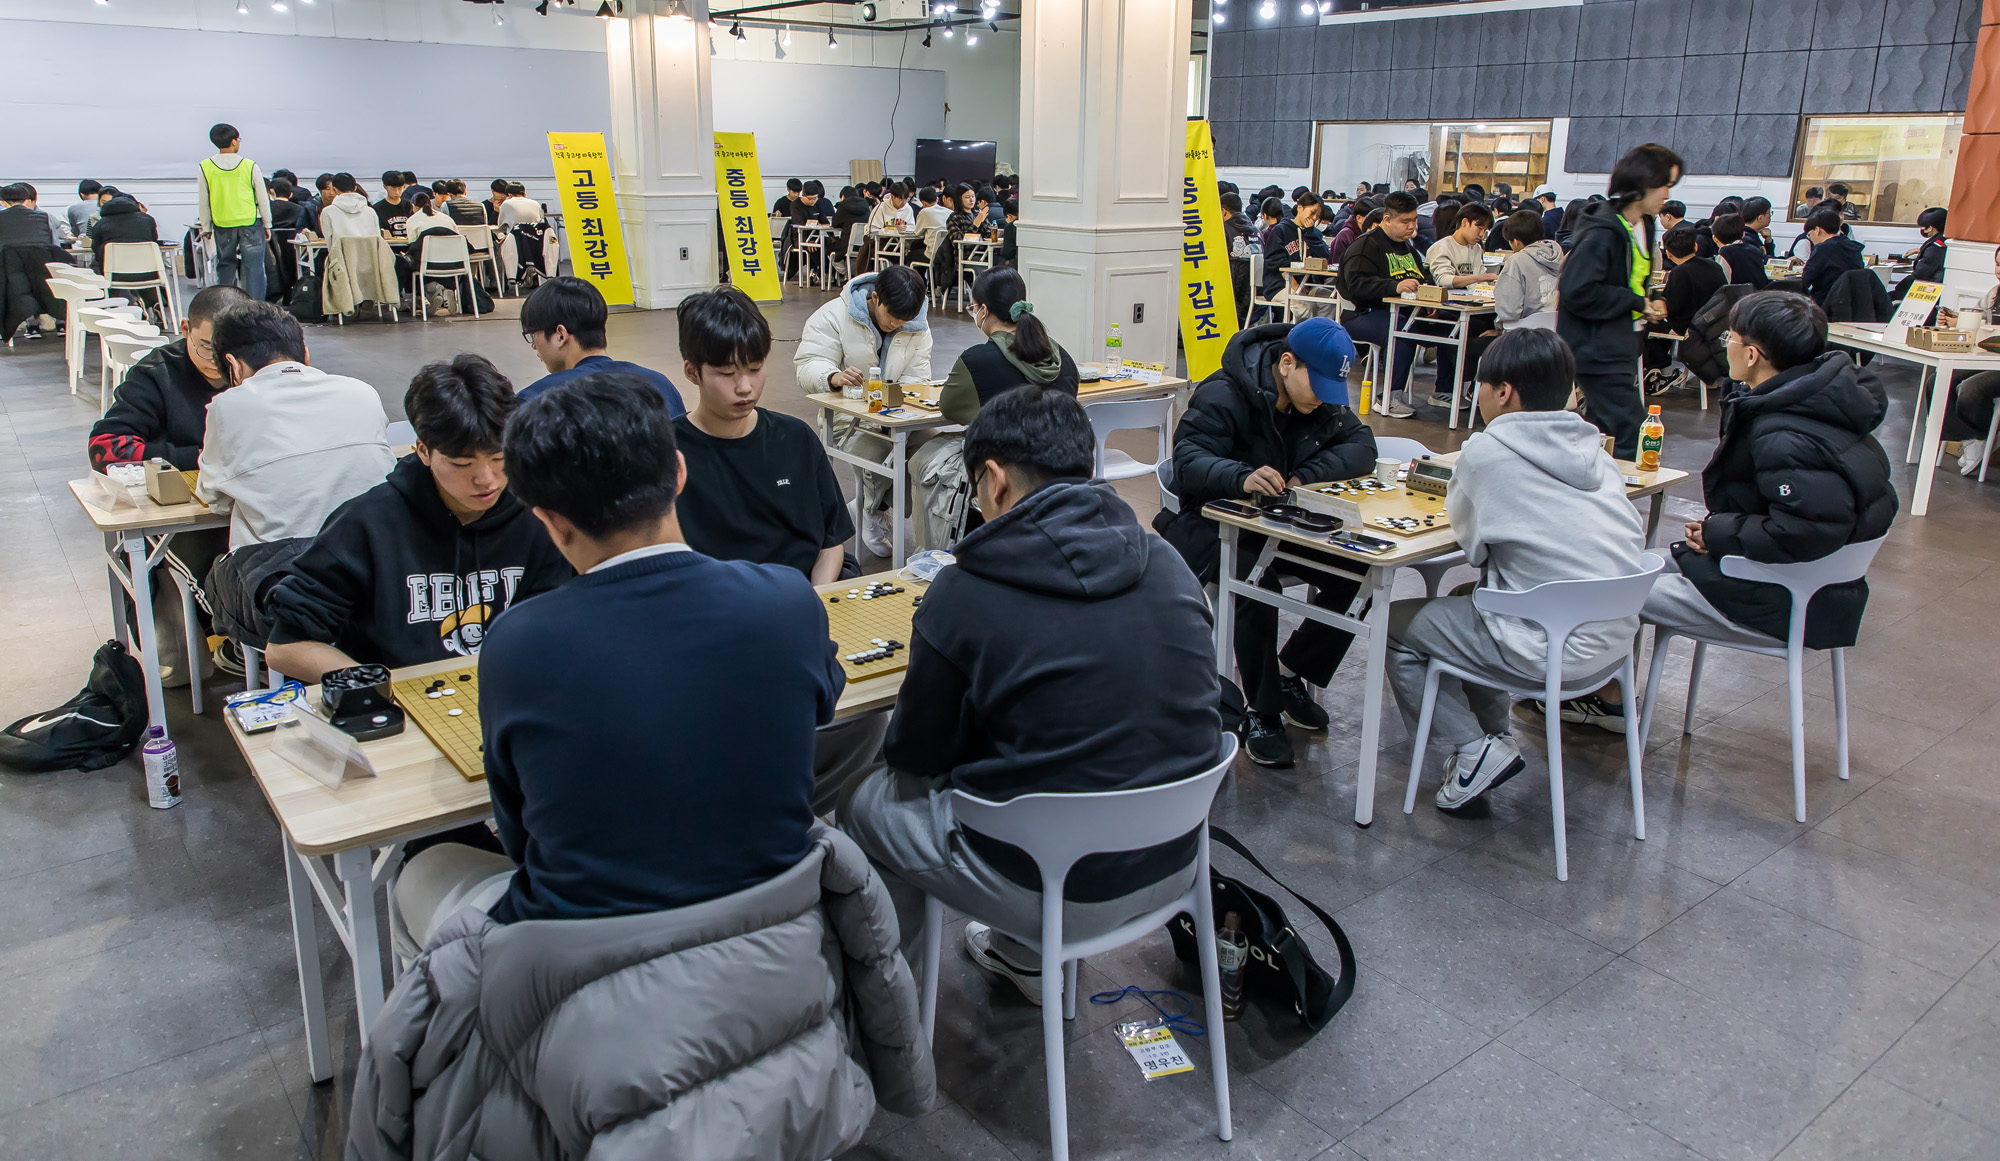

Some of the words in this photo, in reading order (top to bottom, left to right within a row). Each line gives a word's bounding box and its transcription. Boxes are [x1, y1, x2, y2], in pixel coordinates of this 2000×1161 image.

[572, 169, 599, 210] 고등
[725, 168, 749, 208] 중등
[581, 217, 613, 280] 최강부
[734, 215, 762, 277] 최강부
[1187, 280, 1221, 341] 갑조
[1143, 1055, 1186, 1071] 명우찬
